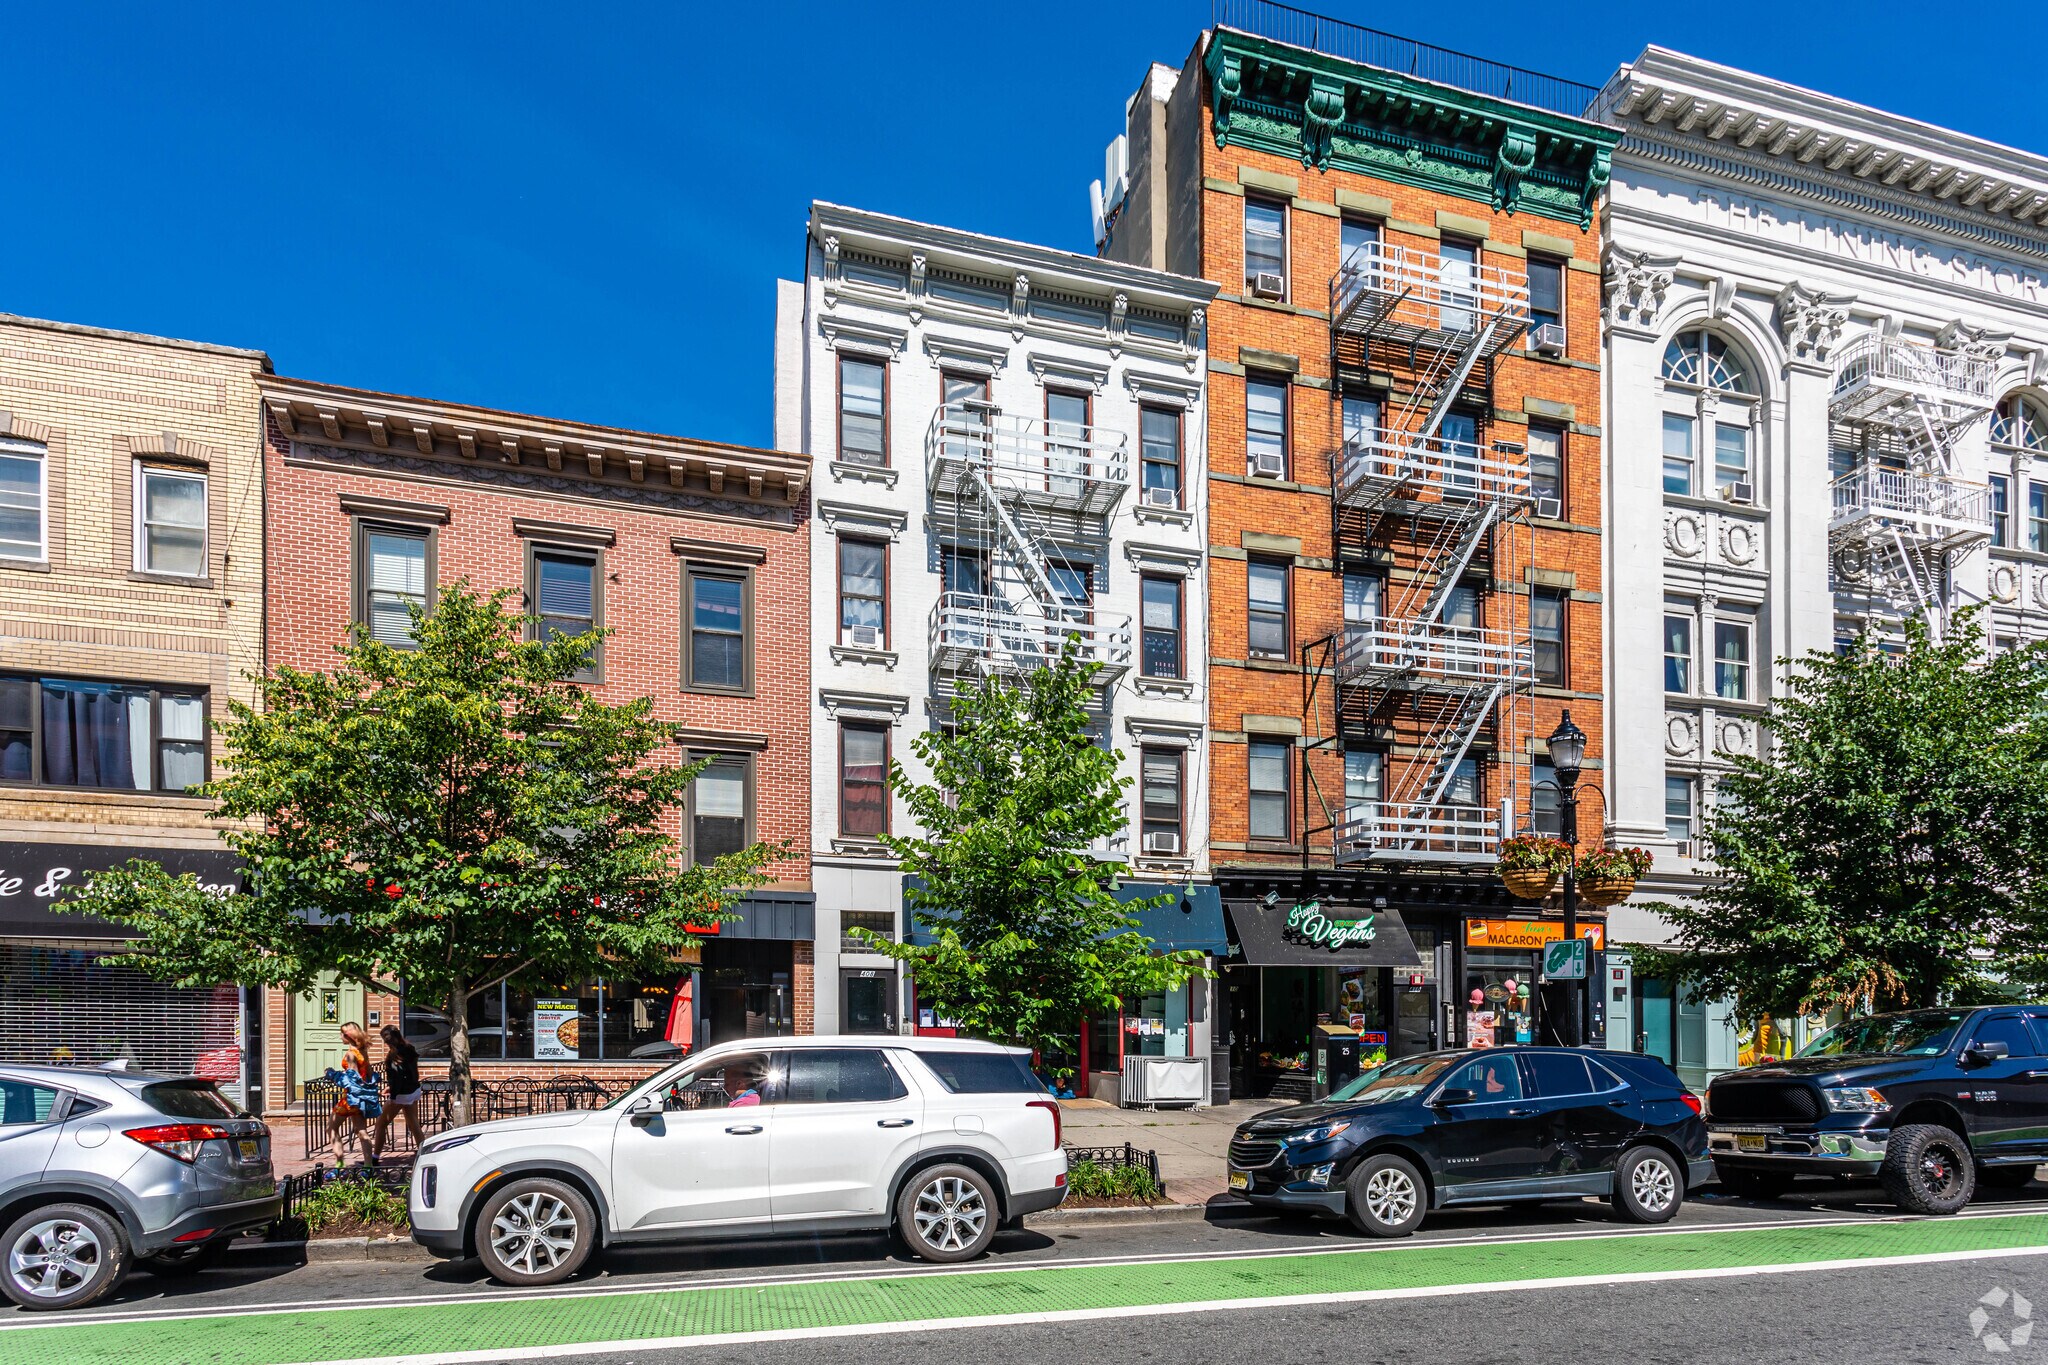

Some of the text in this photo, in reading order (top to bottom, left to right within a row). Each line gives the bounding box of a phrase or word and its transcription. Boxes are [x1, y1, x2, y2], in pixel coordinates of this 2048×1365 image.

[1288, 902, 1320, 926] Happy
[1302, 914, 1376, 948] Vegans
[1488, 934, 1542, 946] MACARON
[1575, 941, 1583, 956] 2
[1359, 1033, 1385, 1043] PEN
[1342, 1047, 1350, 1055] 25
